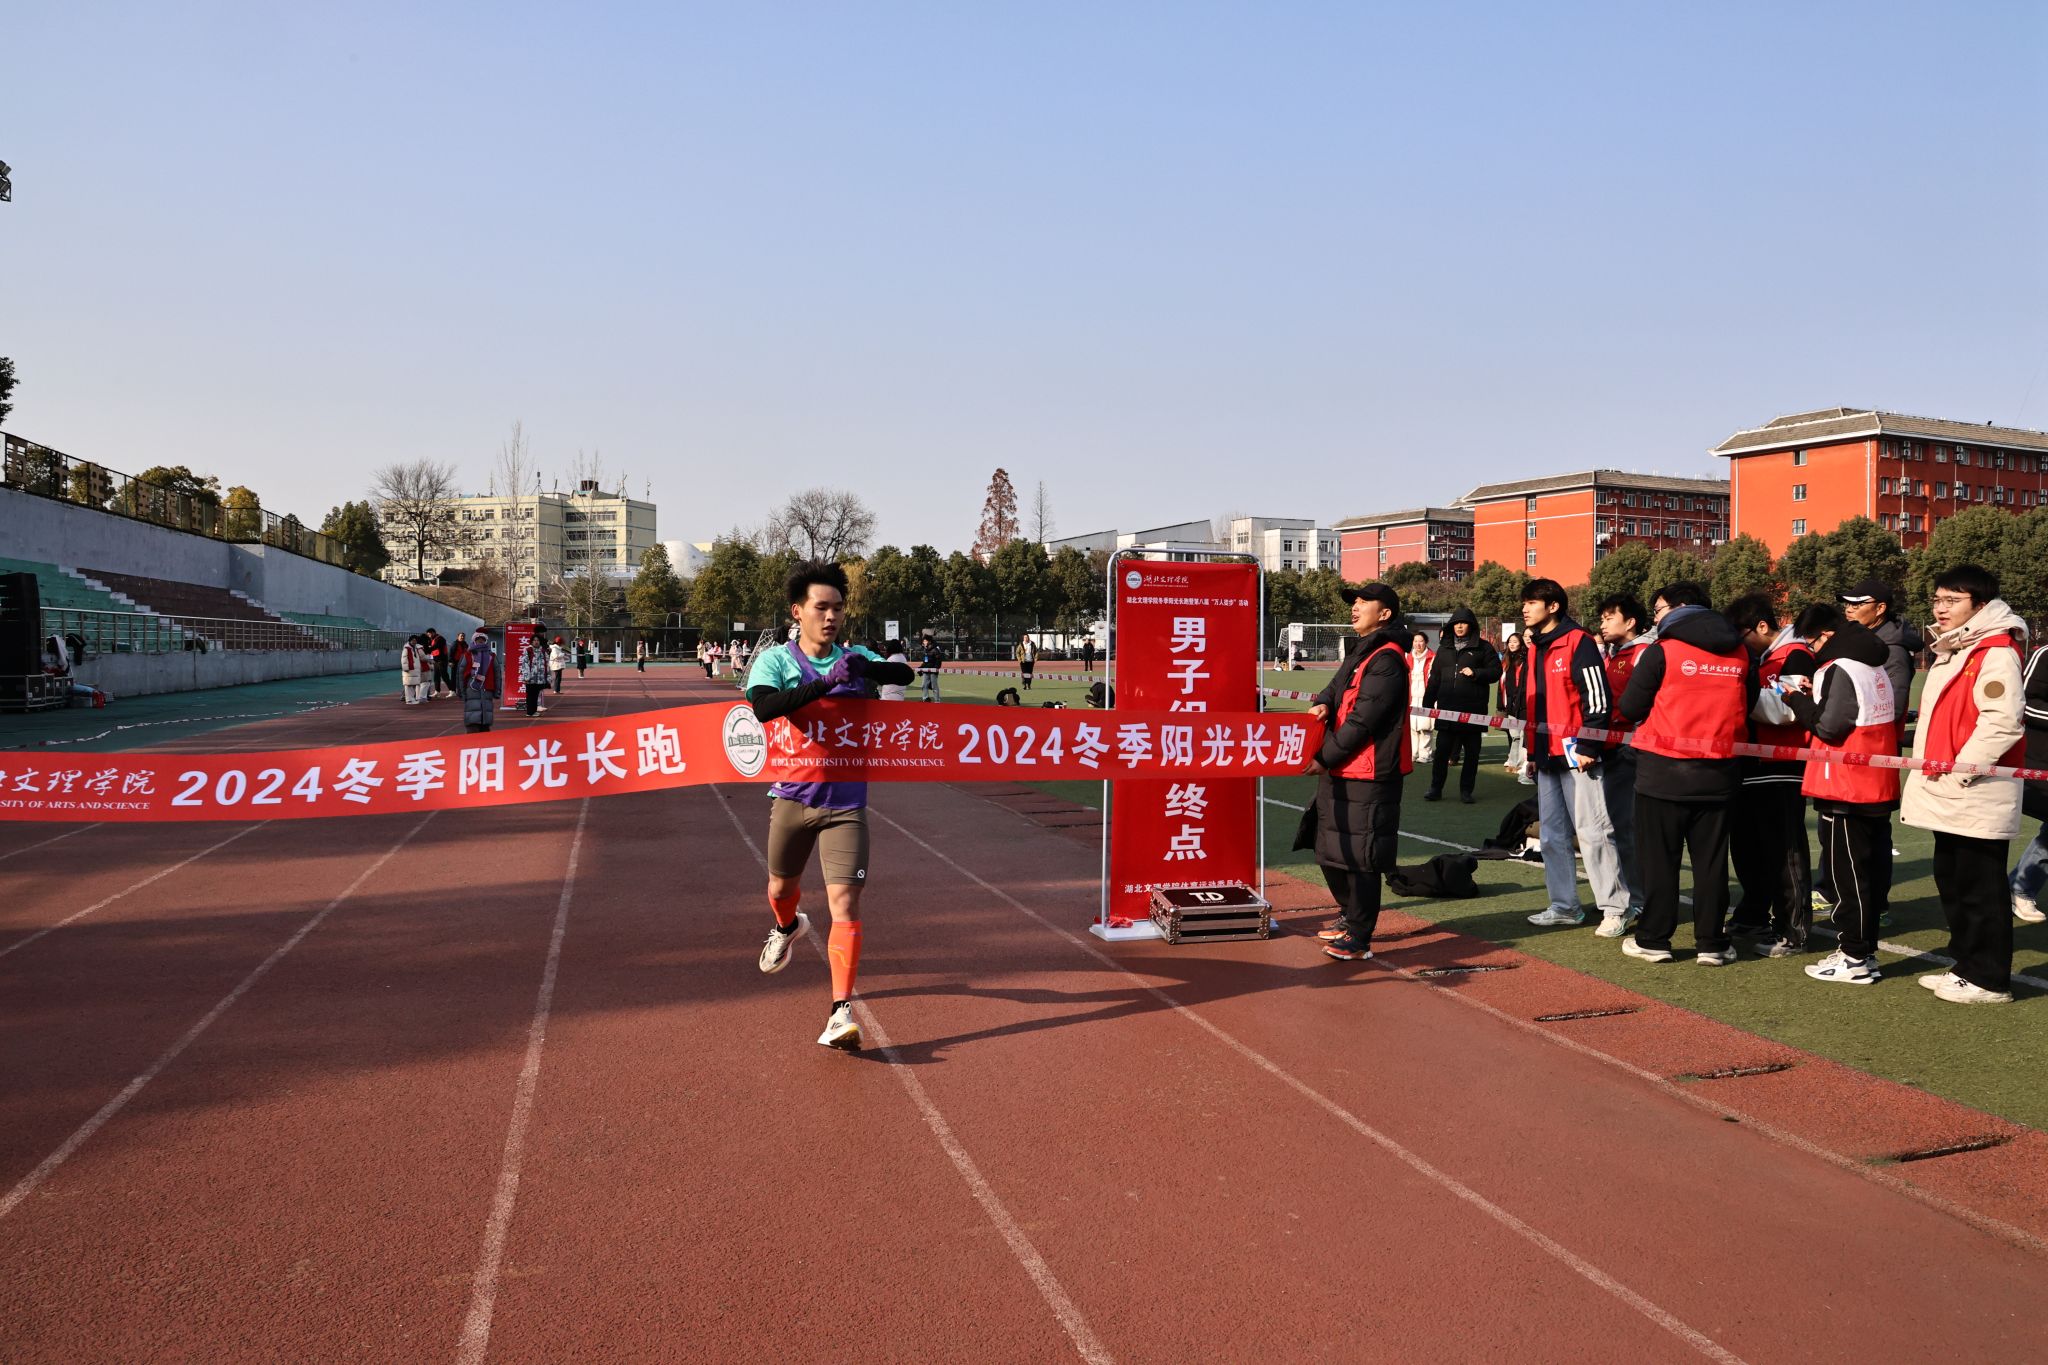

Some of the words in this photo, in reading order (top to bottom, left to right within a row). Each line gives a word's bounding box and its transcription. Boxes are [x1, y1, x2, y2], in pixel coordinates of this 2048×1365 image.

[769, 717, 944, 754] 湖北文理学院
[958, 722, 1306, 769] 2024冬季阳光长跑
[171, 724, 686, 806] 2024冬季阳光长跑
[790, 757, 850, 767] UNIVERSITY
[852, 758, 864, 767] OF
[866, 758, 889, 767] ARTS
[890, 758, 908, 767] AND
[909, 758, 945, 767] SCIENCE
[28, 800, 45, 809] OF
[45, 801, 76, 809] ARTS
[76, 801, 102, 810] AND
[102, 802, 150, 810] SCIENCE
